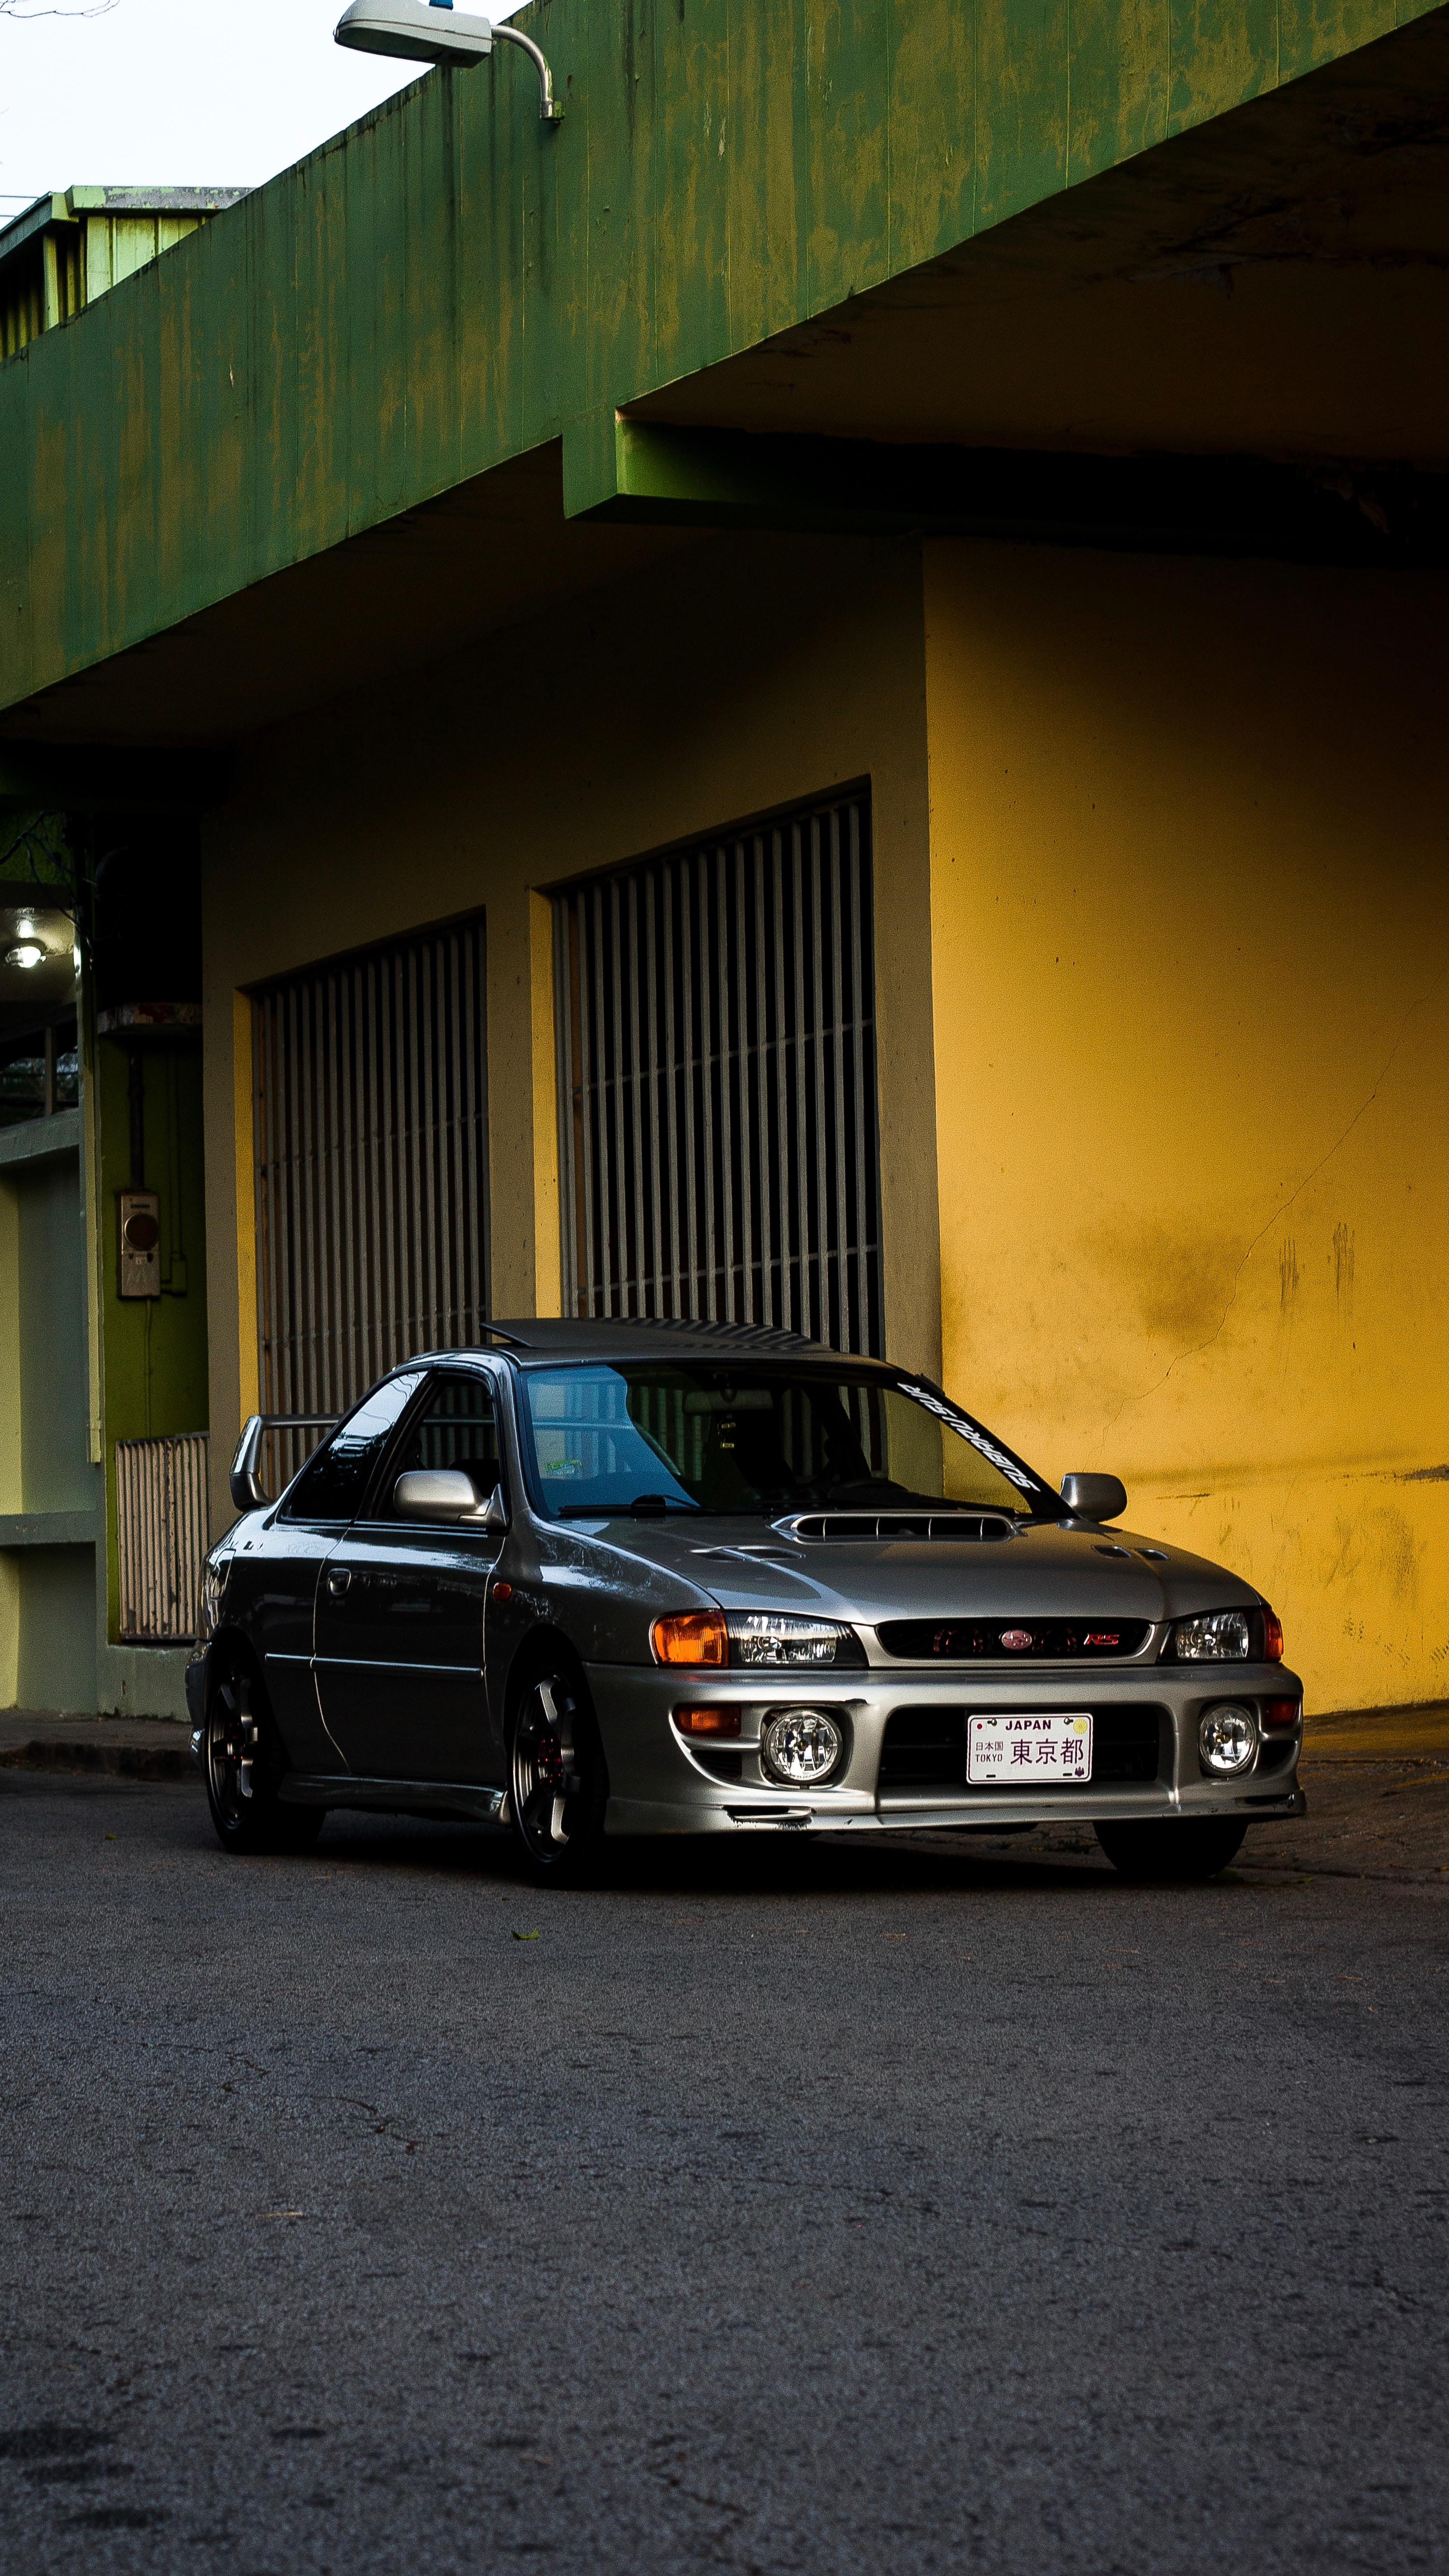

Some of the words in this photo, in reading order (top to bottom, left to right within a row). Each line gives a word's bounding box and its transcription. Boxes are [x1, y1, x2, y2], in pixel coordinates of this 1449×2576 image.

[942, 1415, 1041, 1492] SUBARU
[1083, 1633, 1119, 1645] RS
[1005, 1720, 1051, 1731] JAPAN
[1010, 1737, 1084, 1765] 東京都
[975, 1753, 1003, 1763] TOKYO
